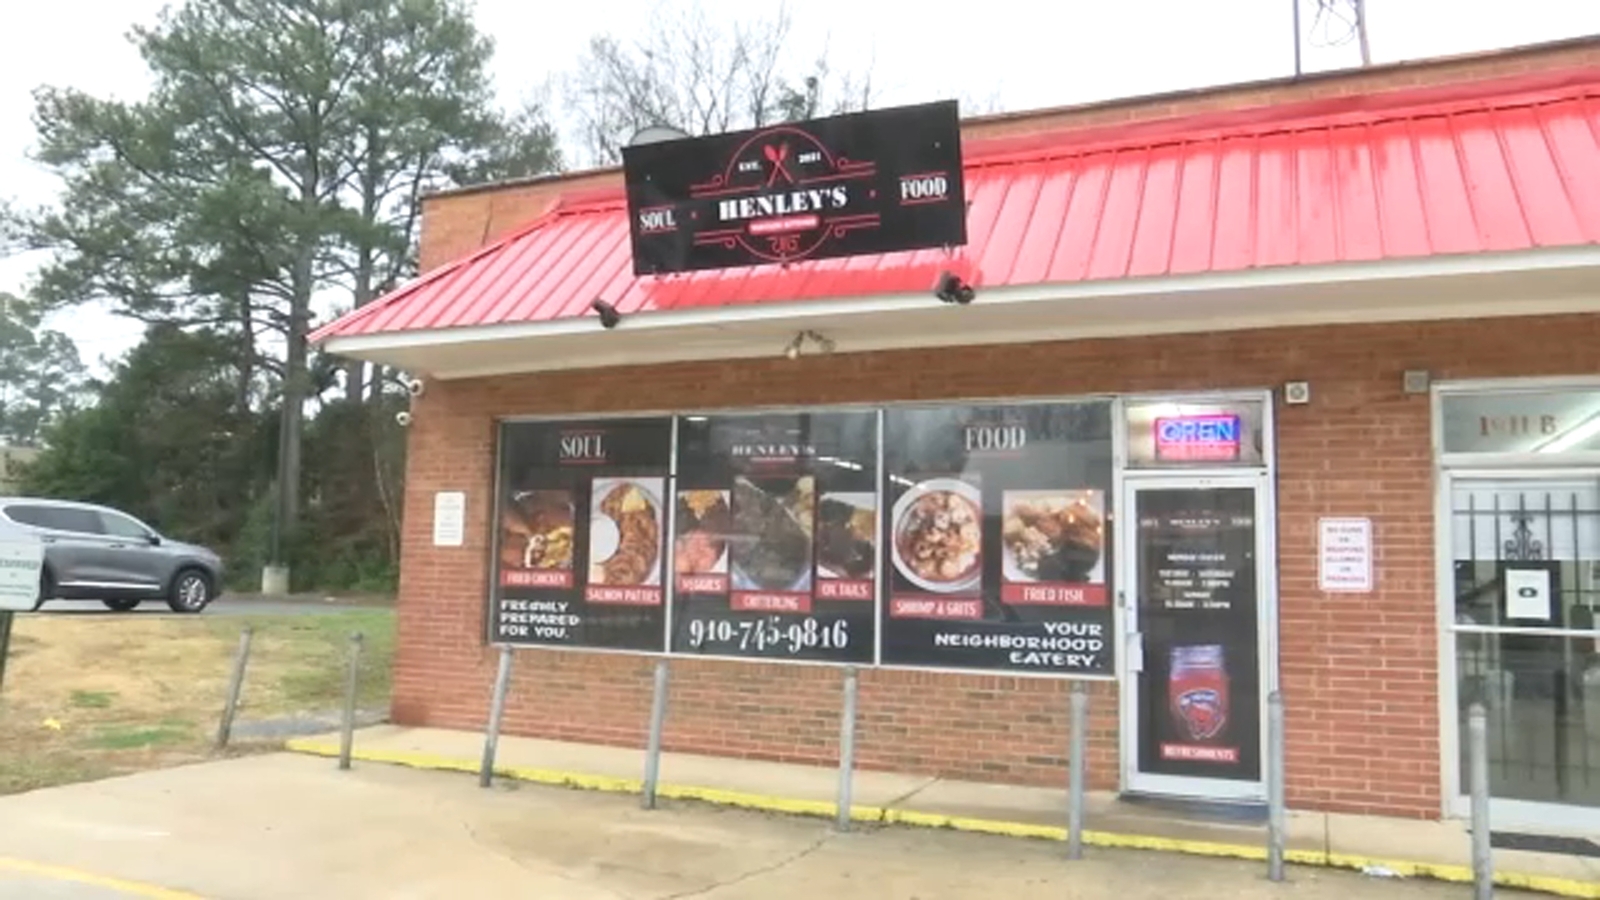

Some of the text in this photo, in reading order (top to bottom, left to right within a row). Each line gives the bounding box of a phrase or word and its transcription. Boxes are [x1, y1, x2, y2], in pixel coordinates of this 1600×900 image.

[900, 177, 947, 201] FOOD
[719, 186, 848, 221] HENLEY'S
[639, 209, 676, 230] SOUL
[966, 426, 1026, 450] FOOD
[1160, 421, 1235, 441] OPEN
[560, 435, 606, 458] SOUL
[507, 572, 567, 585] FRIED CHICKEN
[587, 589, 661, 602] SALMON PATTIES
[839, 584, 868, 597] TAILS
[1023, 588, 1085, 602] FRIED FISH
[897, 601, 935, 614] SHRIMP
[947, 603, 976, 617] GRITS
[501, 612, 580, 627] PREPARED
[500, 625, 570, 639] FOR YOU.
[689, 615, 848, 654] 910-745-9816
[1044, 622, 1102, 636] YOUR
[934, 633, 1103, 651] NEIGHBORHOOD
[1009, 652, 1102, 668] EATERY.
